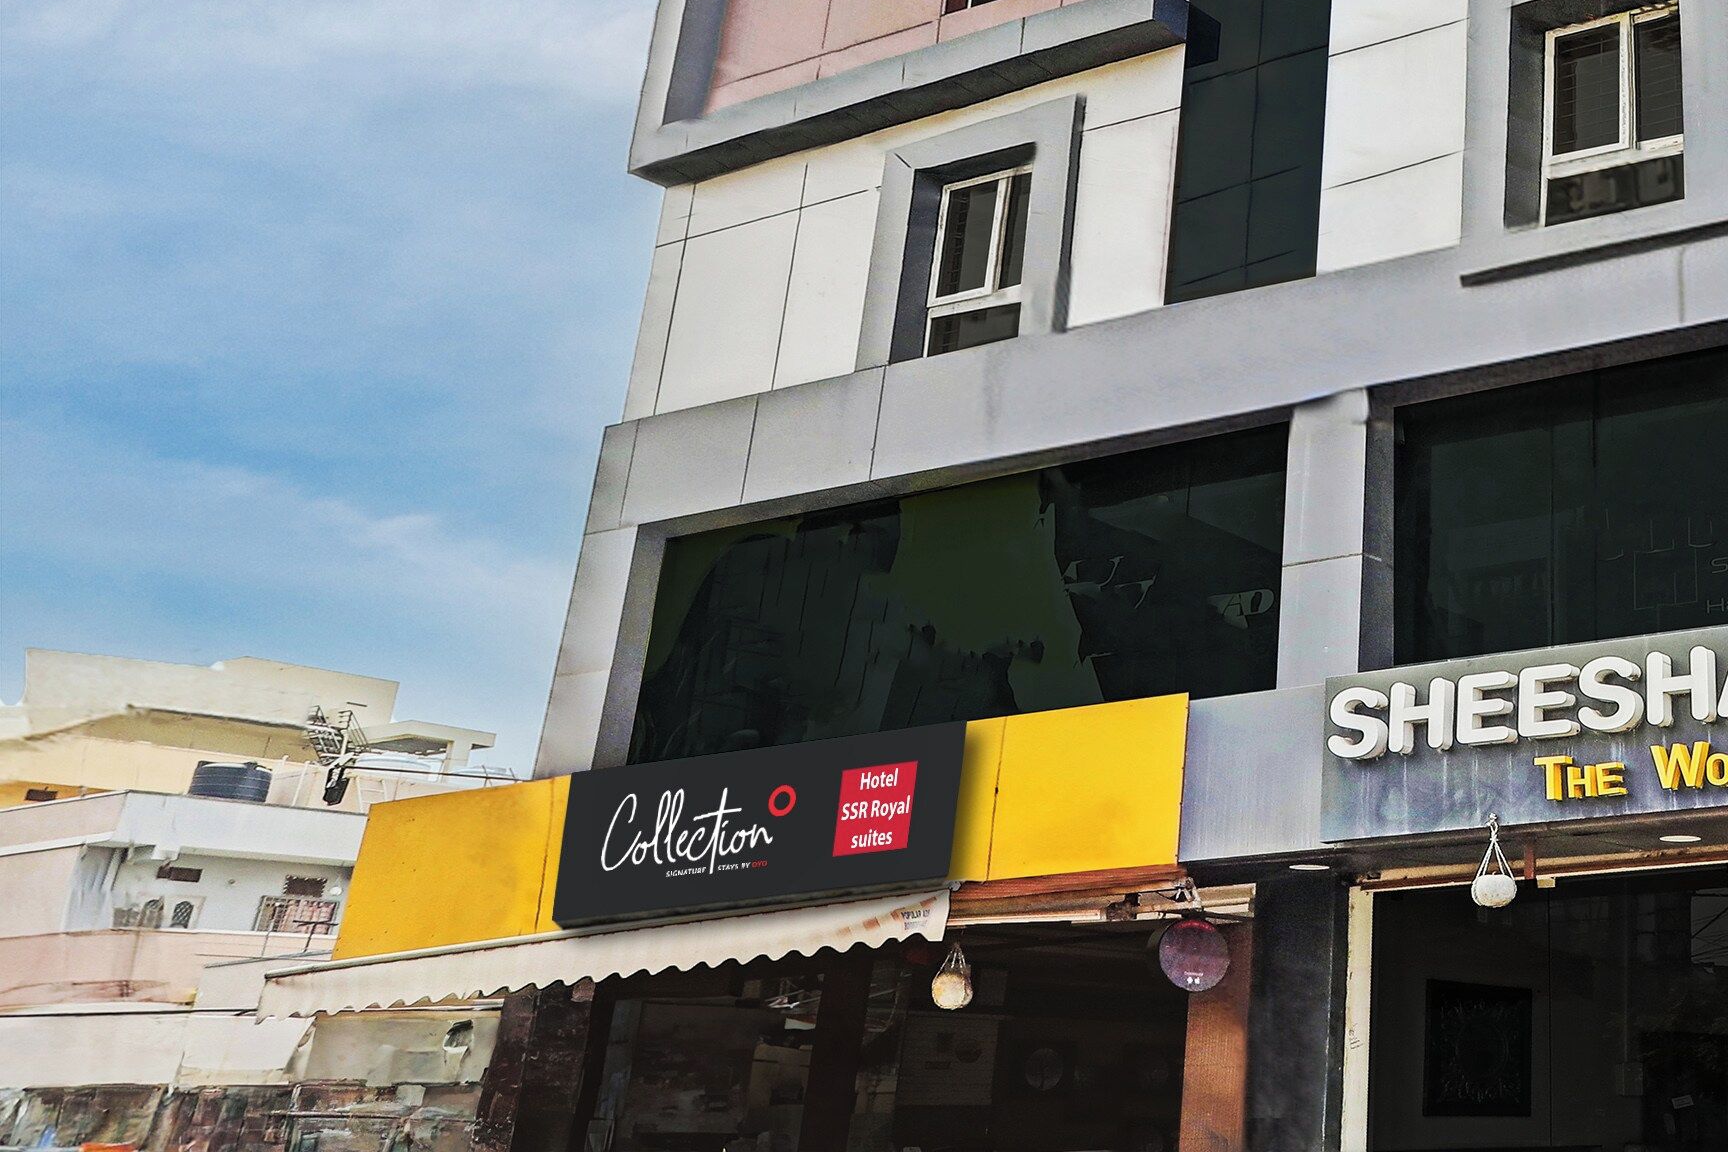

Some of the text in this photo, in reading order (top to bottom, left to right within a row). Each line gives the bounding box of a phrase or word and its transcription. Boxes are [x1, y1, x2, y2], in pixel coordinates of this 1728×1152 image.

[859, 767, 899, 791] Hotel
[841, 794, 911, 822] SSR Royal
[601, 786, 774, 875] Collection
[850, 829, 893, 849] suites
[665, 860, 768, 878] SIGNATURE STAYS BY OYO
